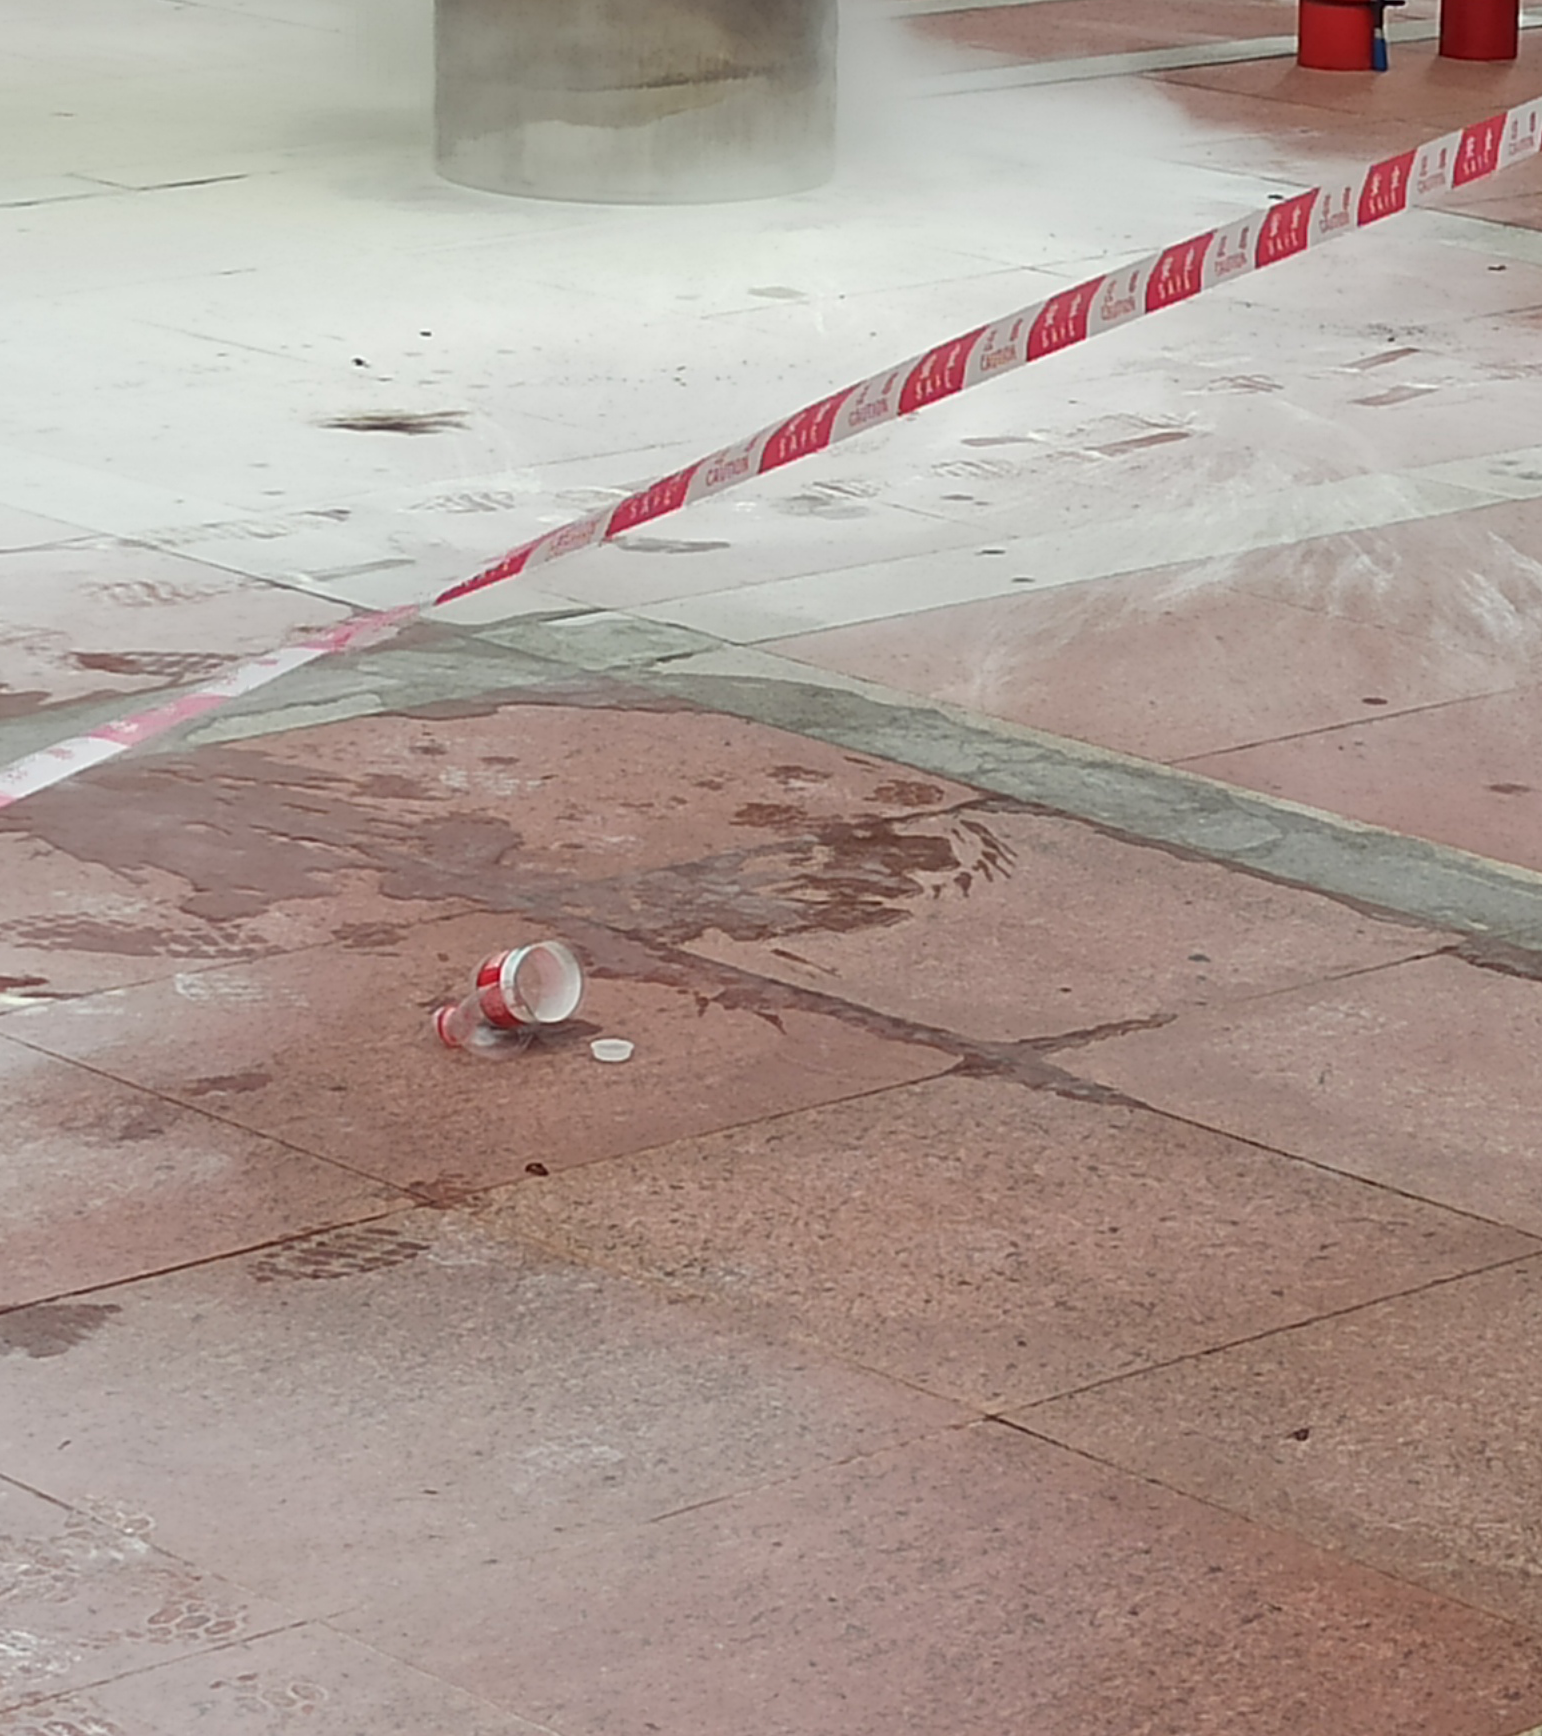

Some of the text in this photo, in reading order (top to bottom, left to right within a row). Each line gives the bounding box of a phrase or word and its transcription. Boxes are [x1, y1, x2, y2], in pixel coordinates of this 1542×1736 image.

[1042, 320, 1075, 348] SAFE
[916, 368, 951, 400] SAFE
[779, 424, 817, 459] SAFE
[706, 457, 749, 486] CAUTION
[630, 490, 670, 519] SAFE
